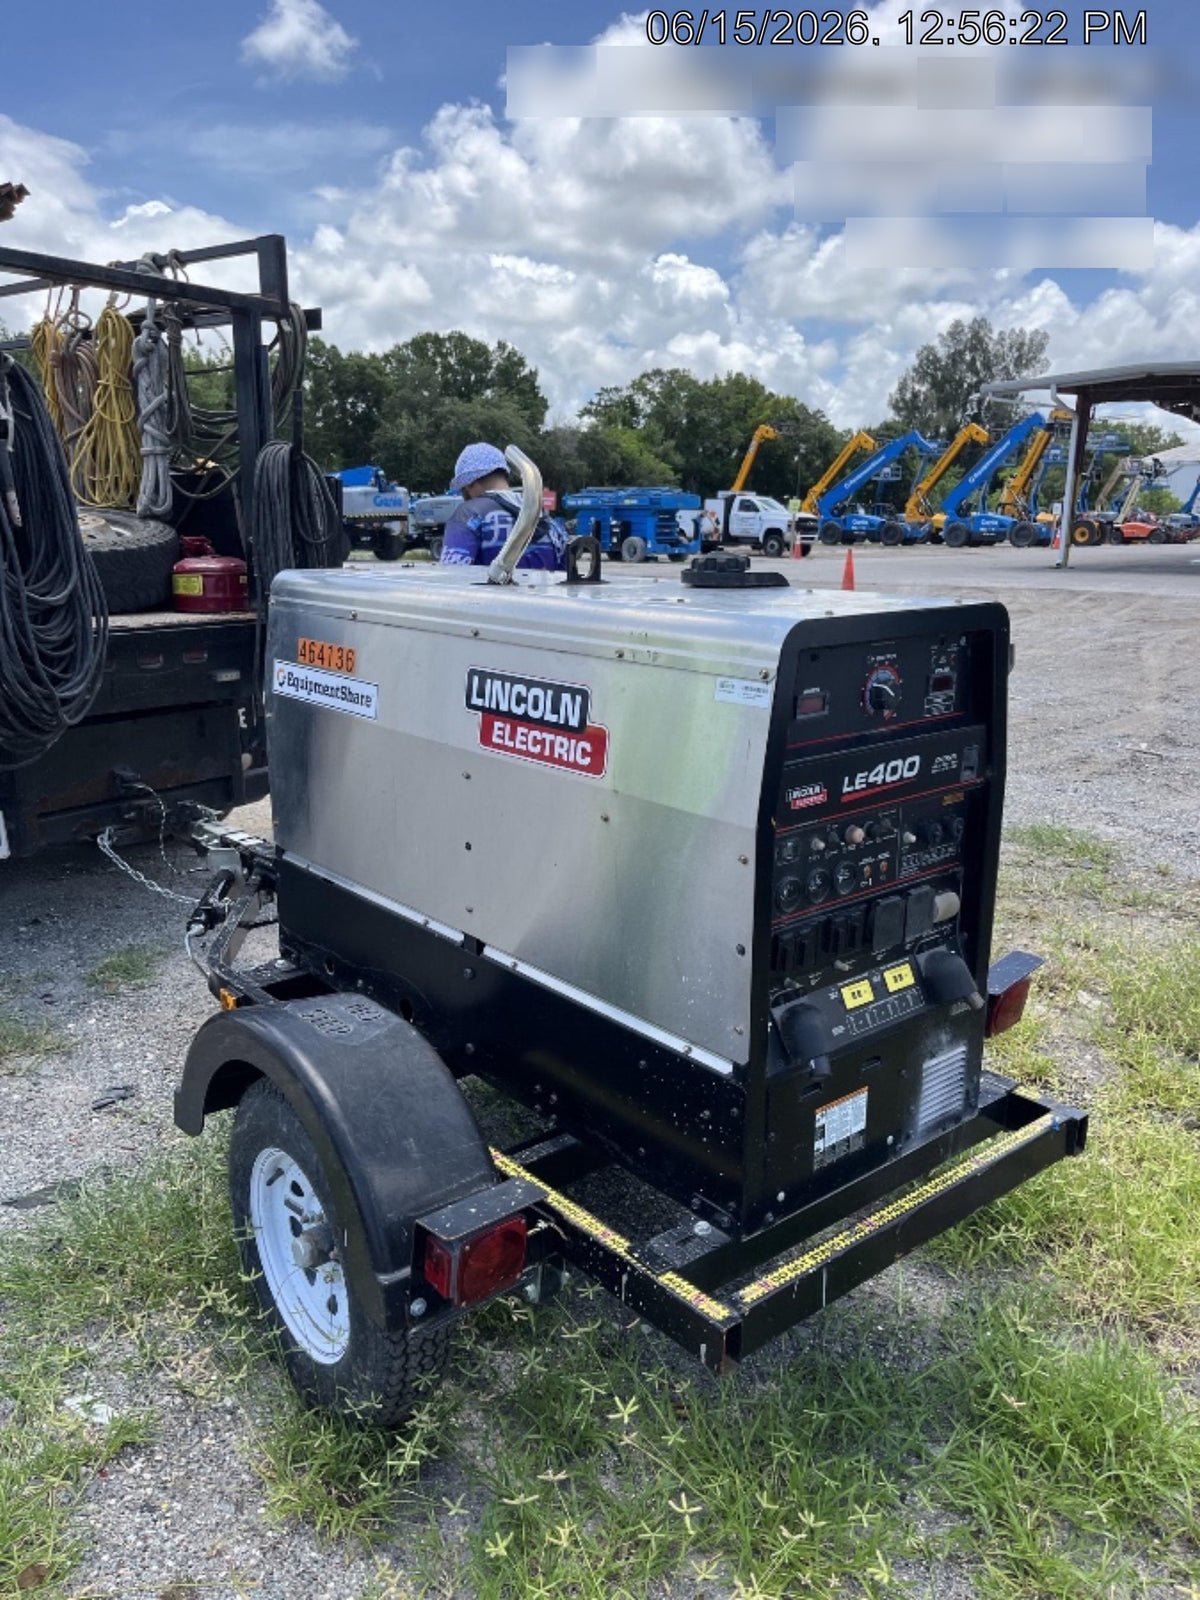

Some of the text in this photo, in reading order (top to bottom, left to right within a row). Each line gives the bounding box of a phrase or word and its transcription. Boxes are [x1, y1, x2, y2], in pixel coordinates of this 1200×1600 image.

[299, 639, 356, 673] 464136
[286, 671, 373, 708] EquipmentShare
[471, 675, 582, 728] LINCOLN
[492, 721, 592, 766] ELECTRIC
[842, 754, 921, 794] LE400
